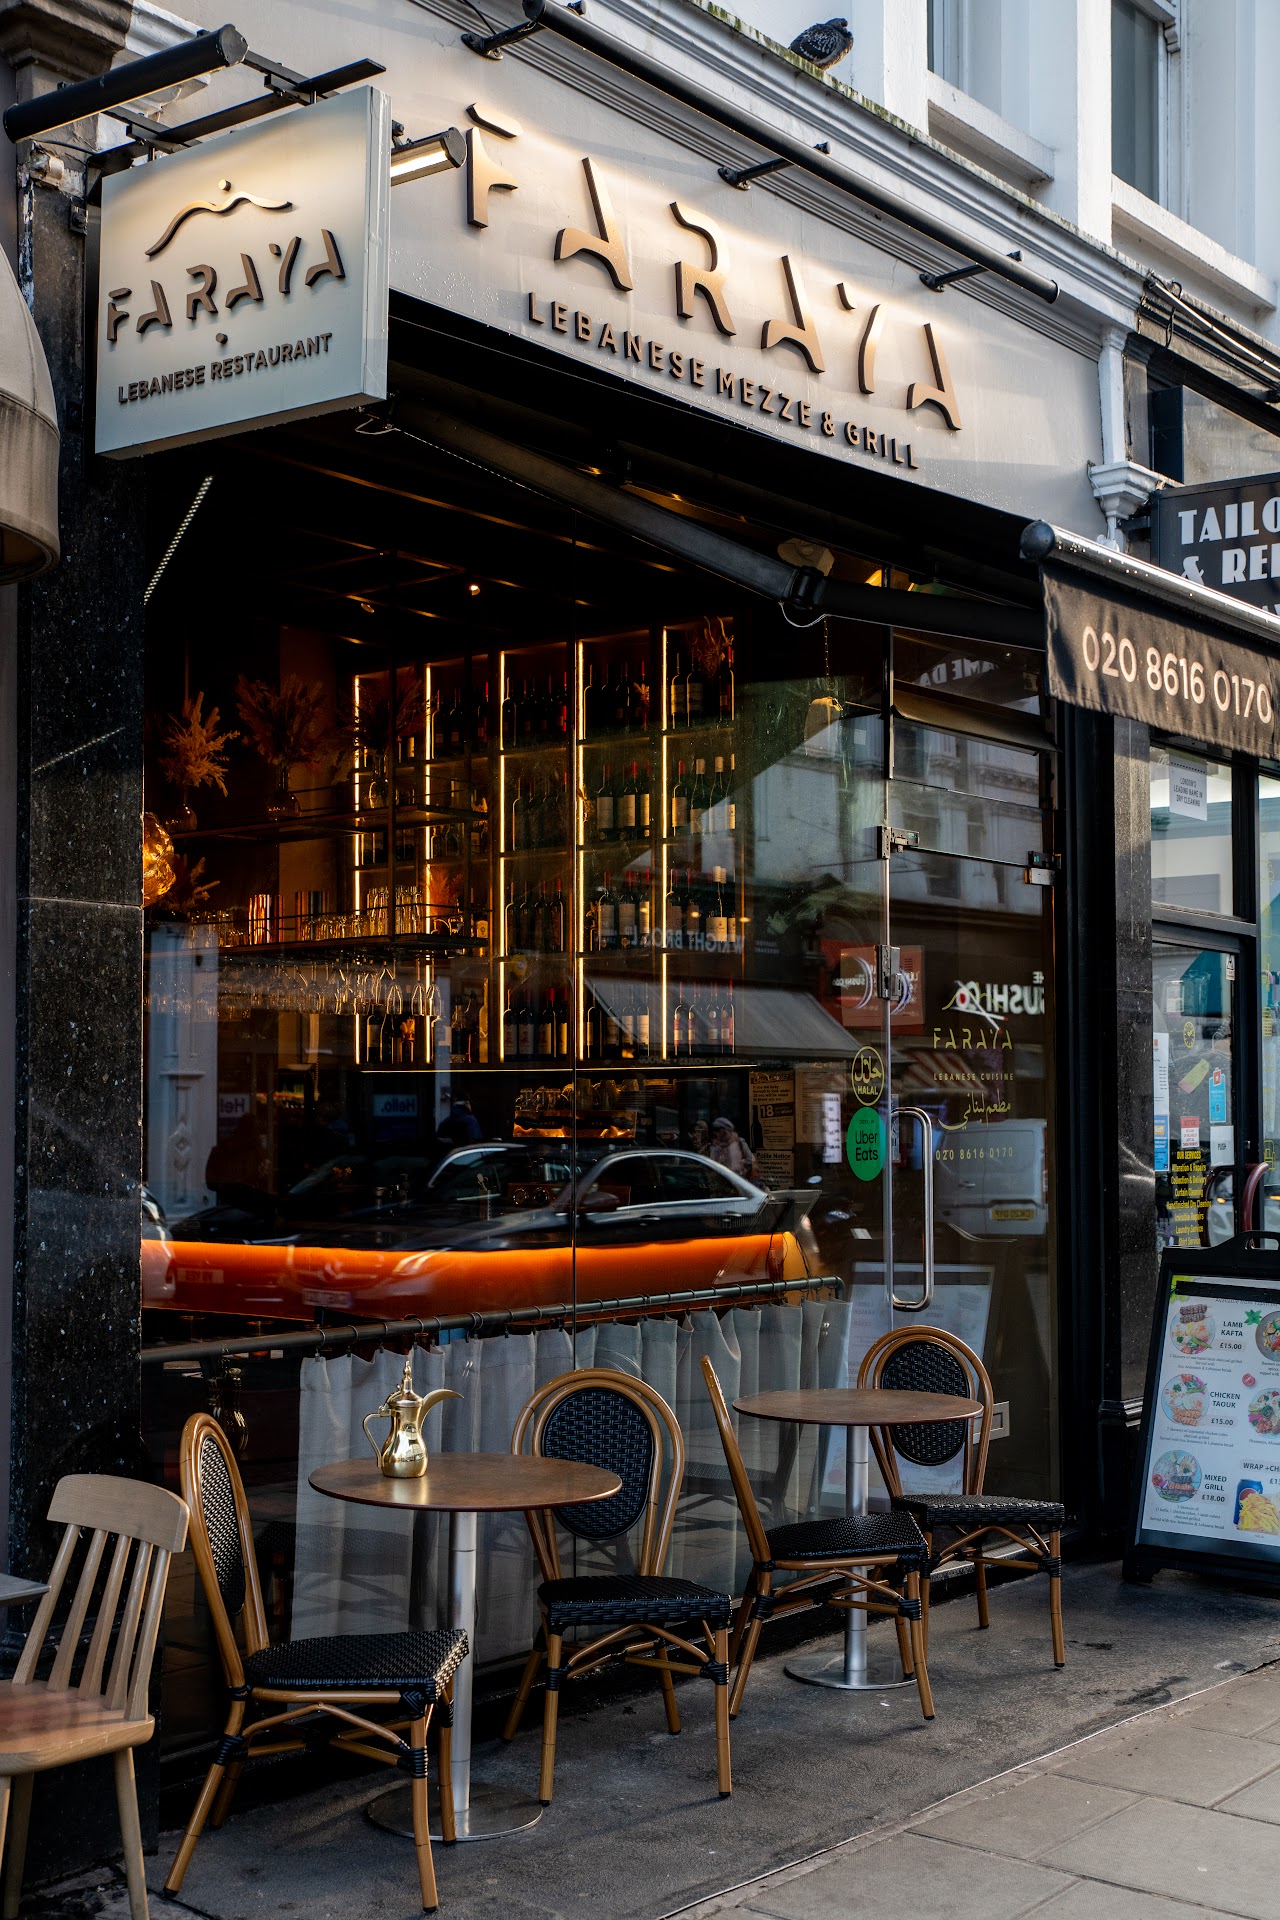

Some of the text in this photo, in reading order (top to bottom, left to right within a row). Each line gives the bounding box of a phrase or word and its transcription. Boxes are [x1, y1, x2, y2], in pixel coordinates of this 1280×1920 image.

[466, 102, 963, 431] FARAYA
[107, 229, 346, 342] FARAYA
[118, 332, 333, 404] LEBANESE RESTAURANT
[528, 292, 921, 470] LEBANESE MEZZE & GRILL
[1181, 555, 1205, 586] &
[1082, 626, 1272, 724] 020 8616 0170
[1174, 784, 1188, 795] LEADING
[1184, 796, 1200, 807] CLEANING
[933, 1027, 1013, 1050] FARAYA
[933, 1072, 1014, 1081] LEBANESE CUISINE
[858, 1086, 878, 1096] HALAL
[760, 1104, 774, 1118] 18
[855, 1130, 878, 1144] Uber
[856, 1146, 878, 1162] Eats
[936, 1147, 1013, 1161] 020 8616 0170
